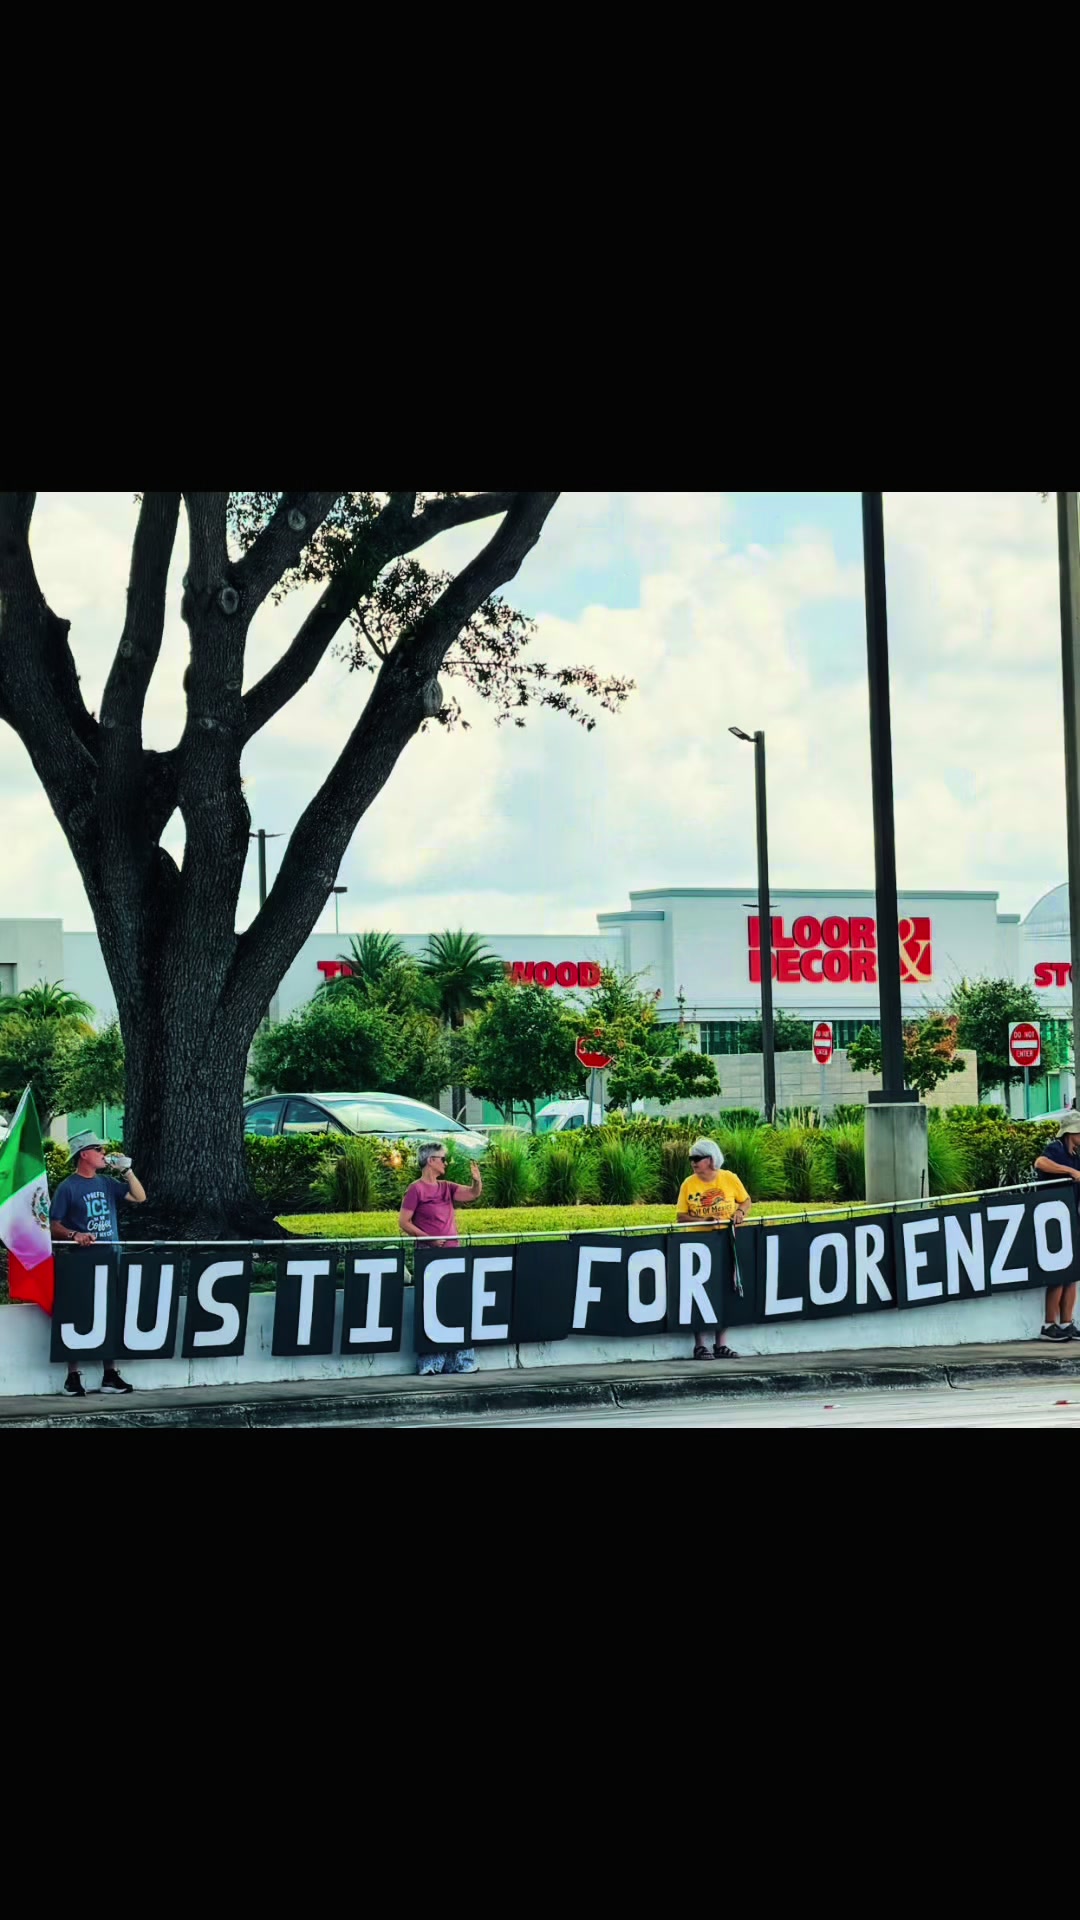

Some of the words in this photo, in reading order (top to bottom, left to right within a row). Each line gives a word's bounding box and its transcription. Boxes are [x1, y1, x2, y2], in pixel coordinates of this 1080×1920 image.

[86, 1199, 110, 1217] ICE
[61, 1256, 513, 1351] JUSTICE
[572, 1242, 718, 1329] FOR
[764, 1200, 1074, 1316] LORENZO
